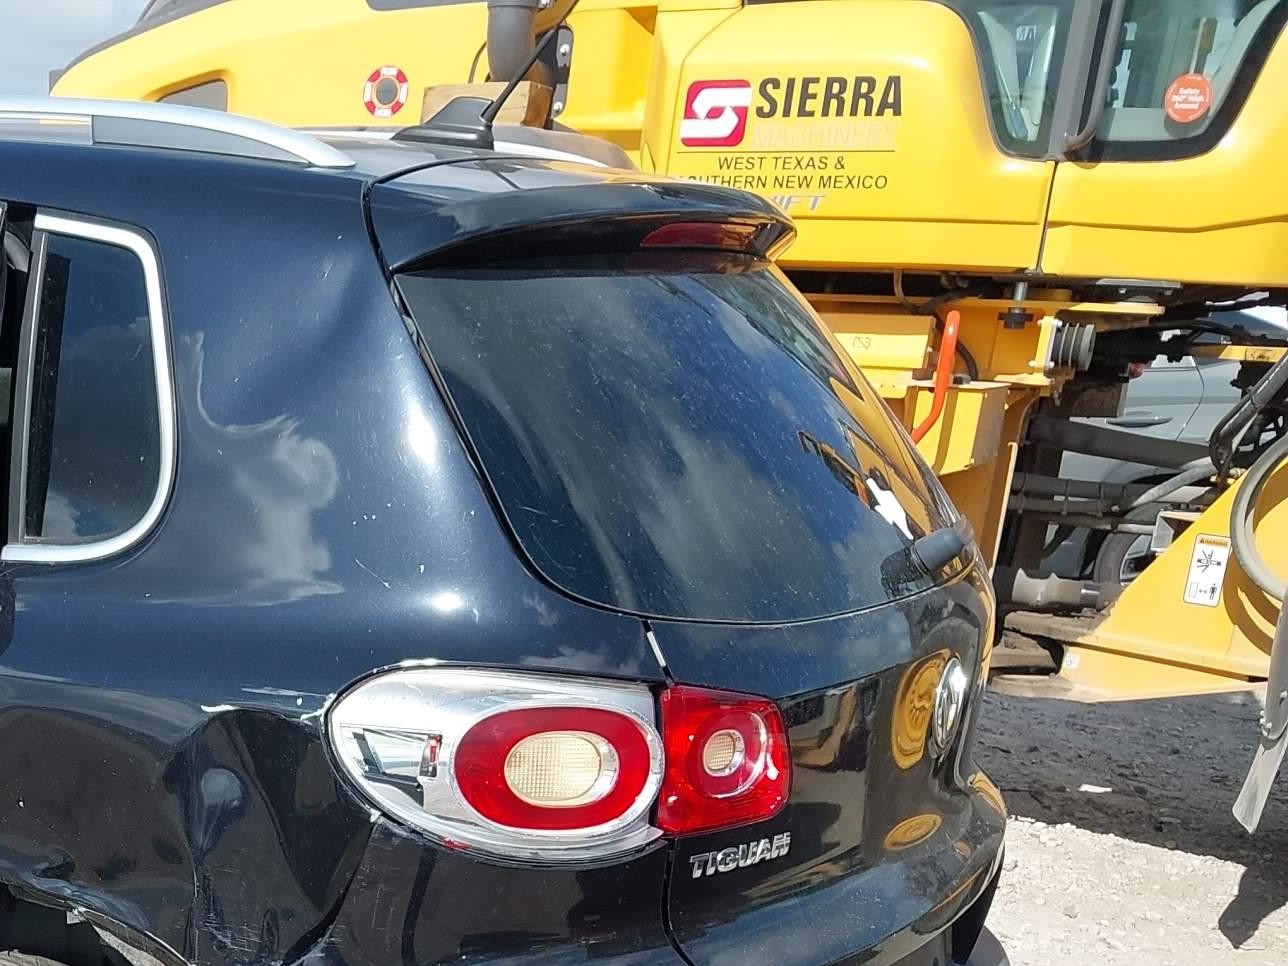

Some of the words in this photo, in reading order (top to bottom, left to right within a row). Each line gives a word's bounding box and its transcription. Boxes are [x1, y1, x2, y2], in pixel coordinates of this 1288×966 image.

[755, 75, 902, 118] SIERRA
[718, 156, 766, 171] WEST
[773, 156, 828, 170] TEXAS
[834, 155, 846, 170] &
[773, 175, 813, 189] NEW
[818, 175, 888, 190] MEXICO
[689, 831, 792, 879] TIGUAN
